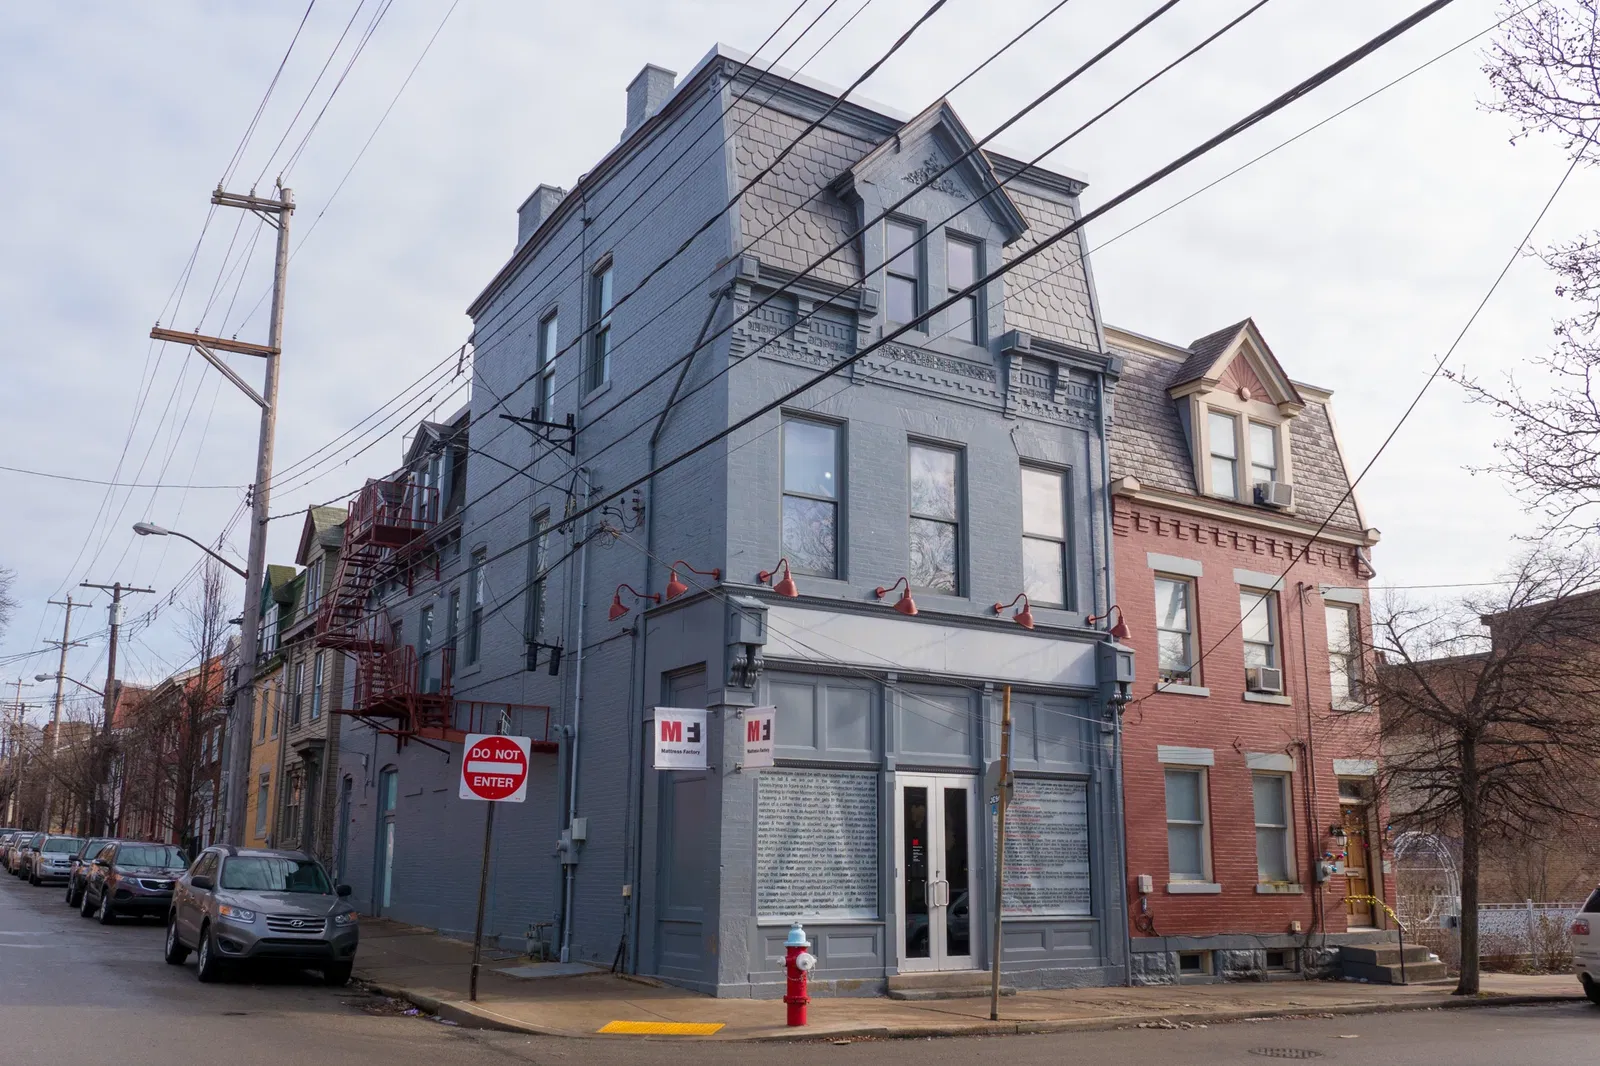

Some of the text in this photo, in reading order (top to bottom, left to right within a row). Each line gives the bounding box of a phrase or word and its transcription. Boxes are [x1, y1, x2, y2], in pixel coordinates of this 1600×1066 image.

[661, 720, 682, 742] M
[747, 720, 760, 742] M
[472, 748, 521, 760] DO NOT
[473, 776, 514, 788] ENTER
